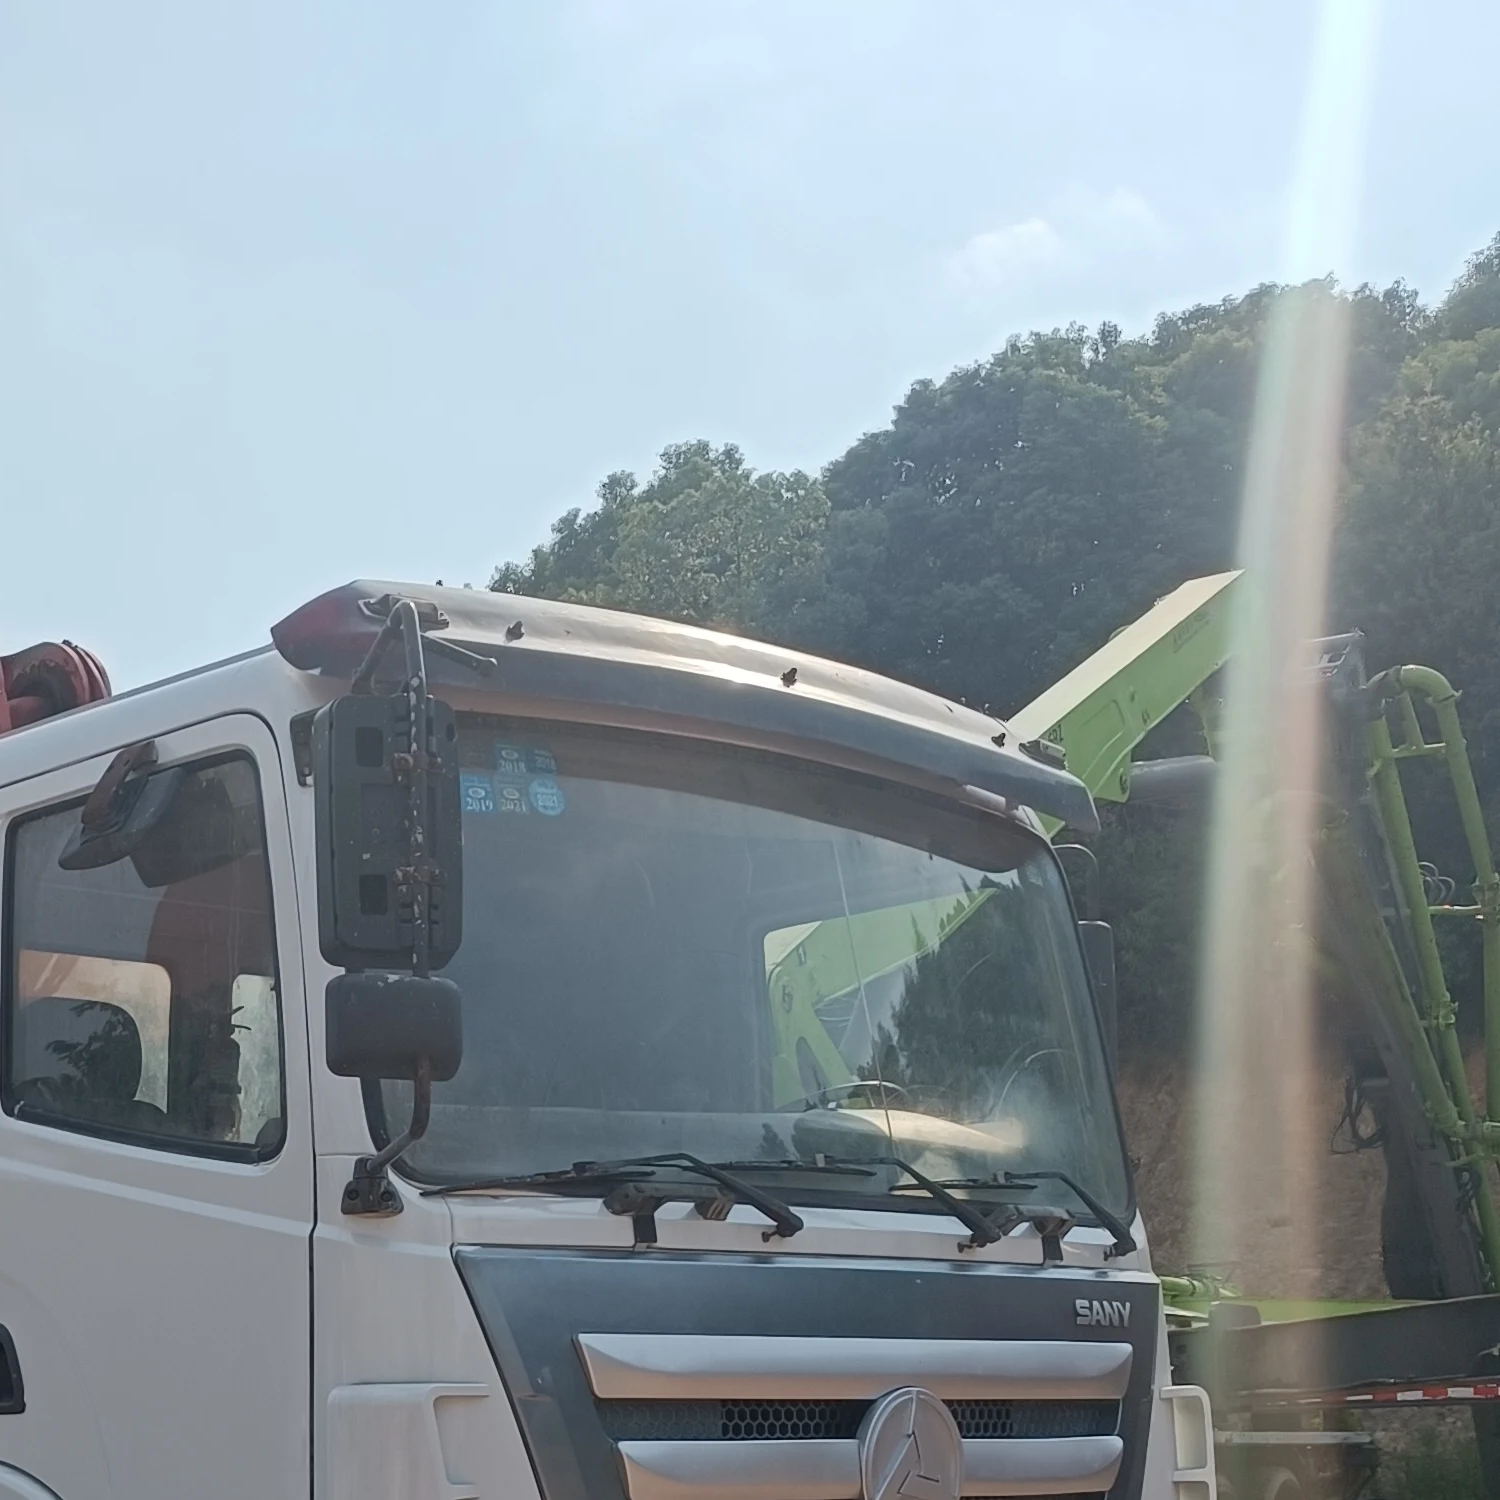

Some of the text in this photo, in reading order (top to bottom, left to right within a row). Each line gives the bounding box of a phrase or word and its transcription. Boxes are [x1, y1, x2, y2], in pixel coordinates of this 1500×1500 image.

[465, 797, 493, 812] 2019
[500, 799, 527, 813] 2021
[1076, 1299, 1131, 1327] SANY
